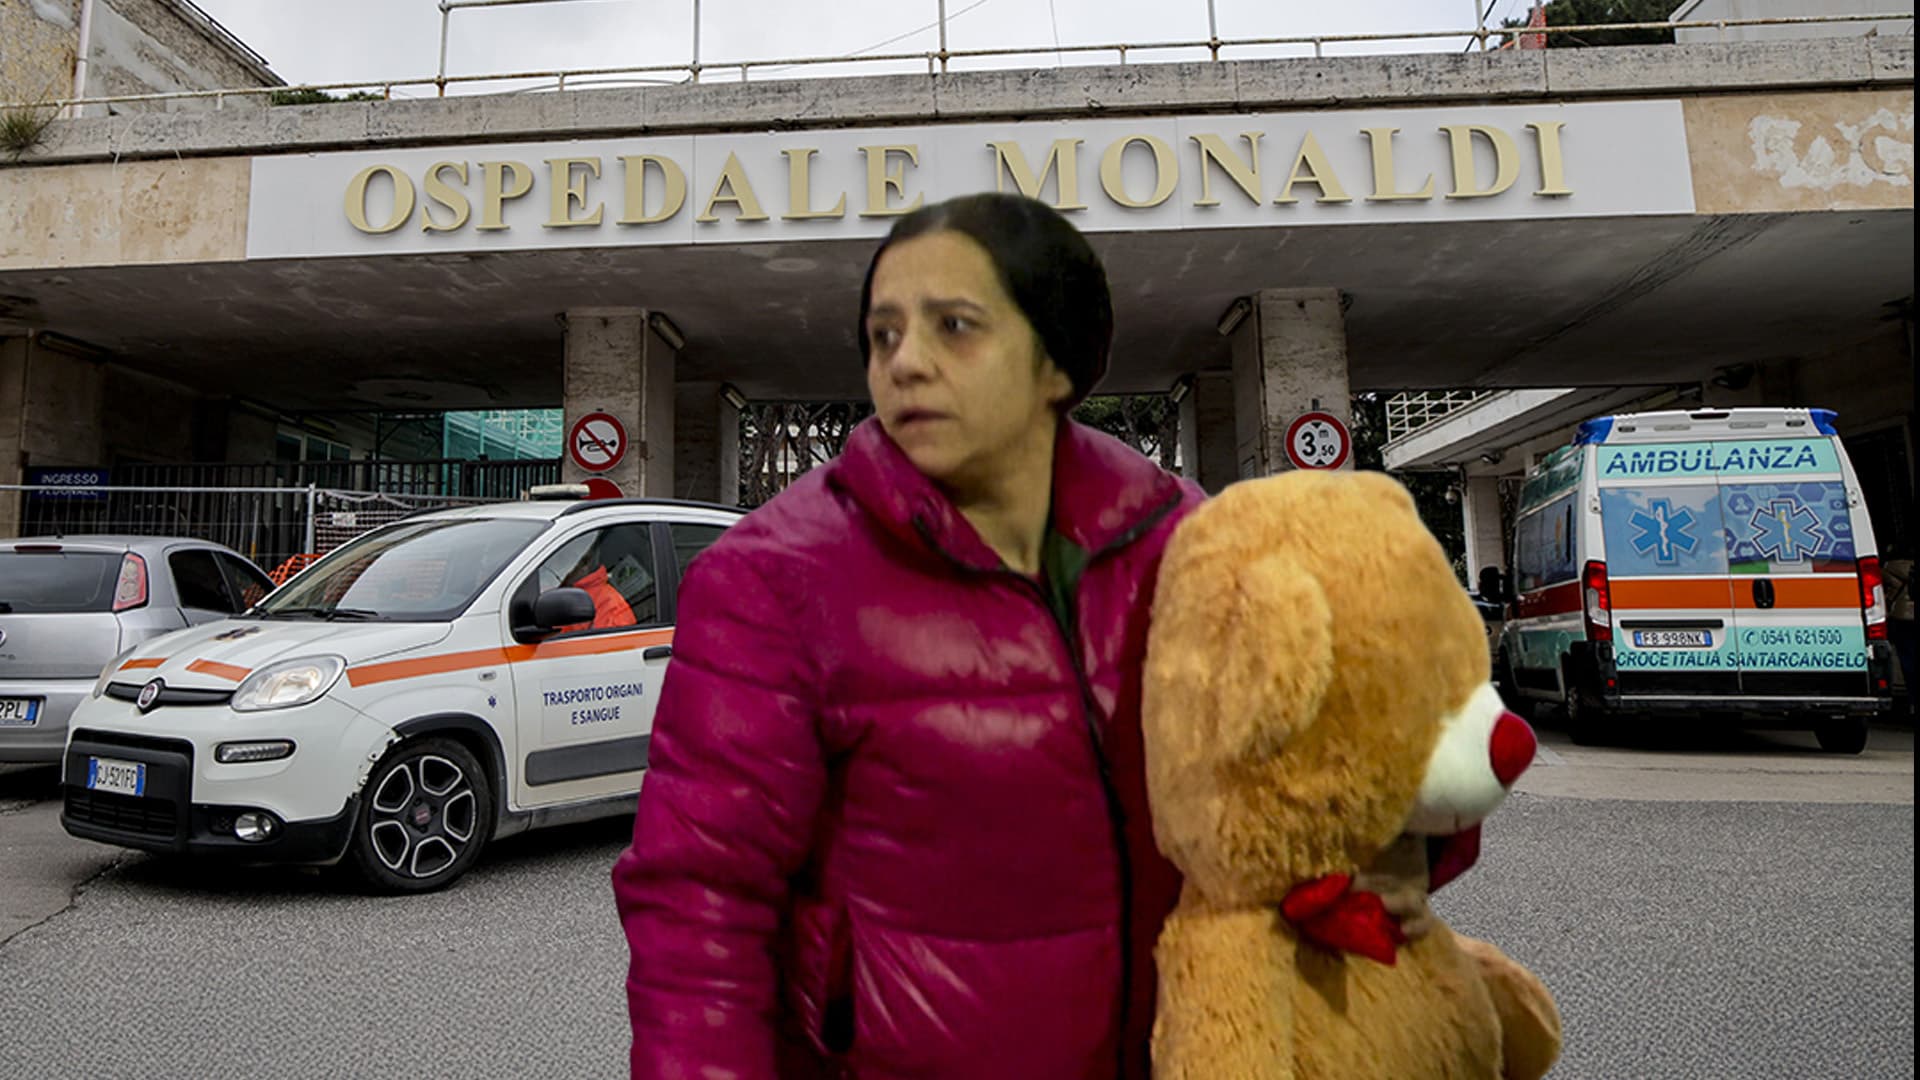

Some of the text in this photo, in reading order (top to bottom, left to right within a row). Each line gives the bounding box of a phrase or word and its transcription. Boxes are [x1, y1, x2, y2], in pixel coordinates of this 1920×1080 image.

[344, 120, 1574, 234] OSPEDALE MONALDI
[1605, 444, 1818, 475] AMBULANZA
[41, 473, 99, 485] INGRESSO
[1761, 629, 1842, 645] 0541 621500
[1616, 651, 1867, 668] CROCE ITALIA SANTARCANGELO
[543, 682, 643, 706] TRASPORTO ORGANI
[571, 706, 620, 725] E SANGUE
